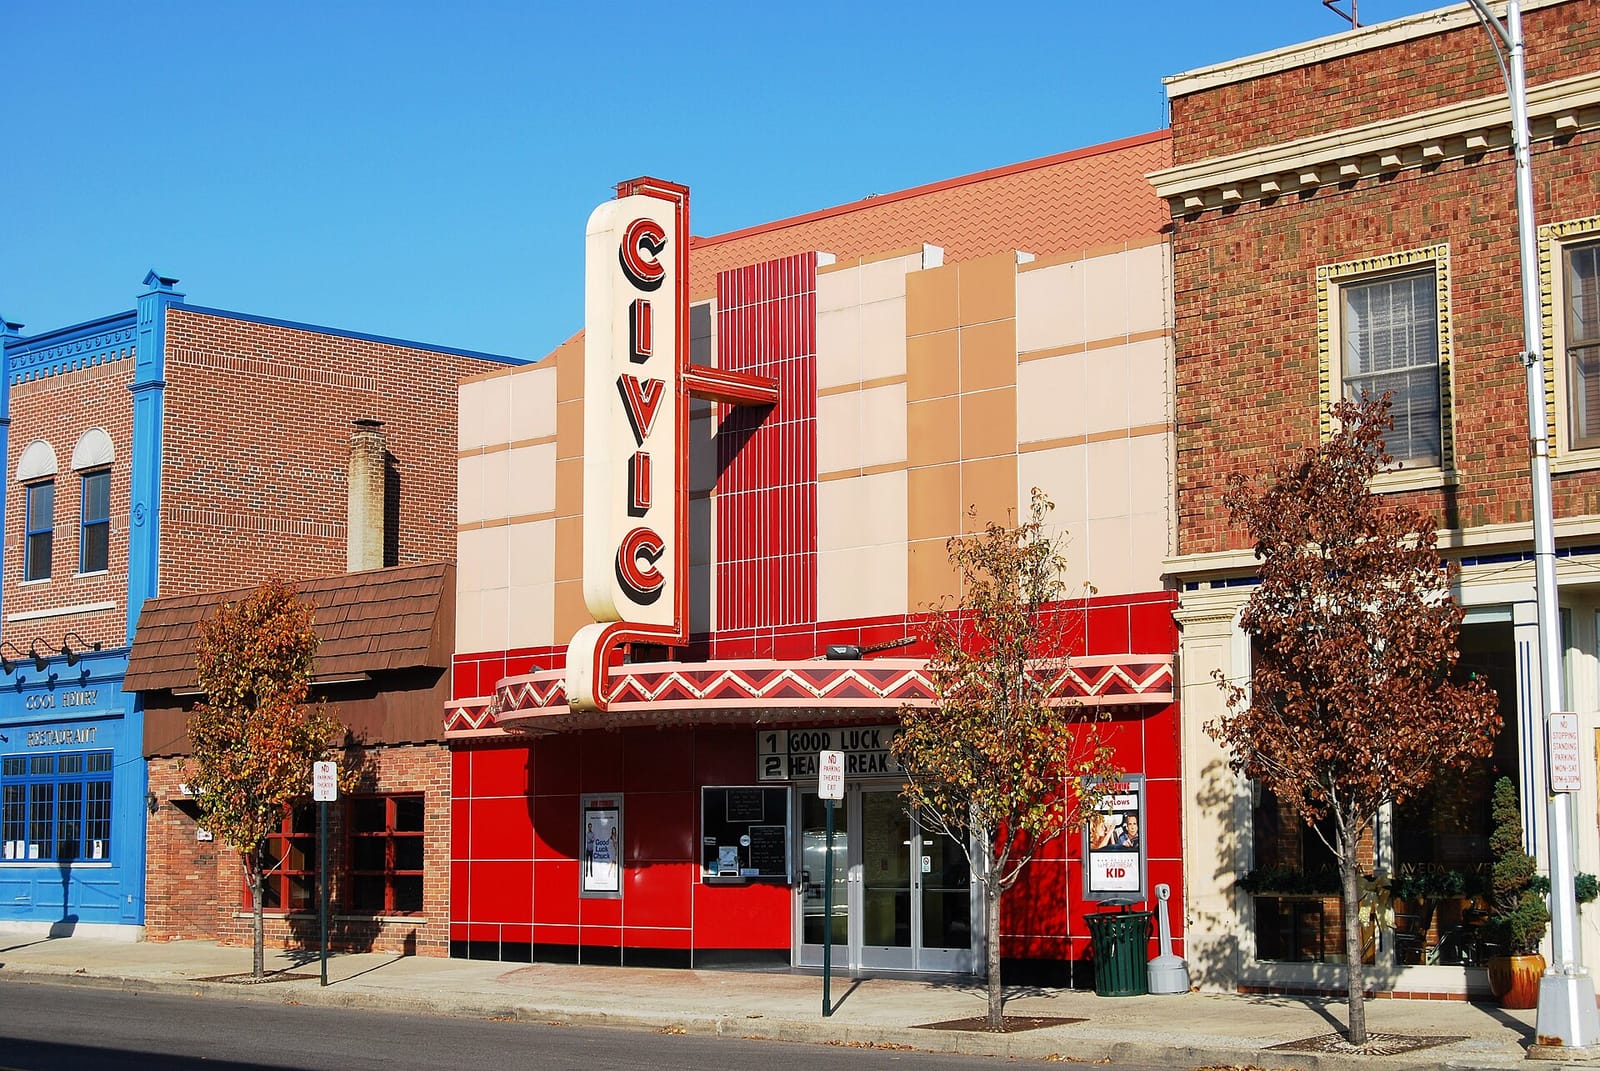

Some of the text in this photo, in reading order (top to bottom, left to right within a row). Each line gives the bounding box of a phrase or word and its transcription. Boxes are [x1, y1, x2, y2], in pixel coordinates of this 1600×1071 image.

[615, 217, 668, 606] CIVIC
[26, 690, 98, 710] COOL HENRY
[27, 727, 97, 747] RESTAURANT
[766, 734, 777, 752] 1
[790, 733, 831, 751] GOOD
[841, 730, 881, 749] LUCK
[1553, 732, 1577, 740] STOPPING
[1553, 743, 1577, 751] STANDING
[765, 757, 782, 776] 2
[828, 755, 837, 764] NO
[1106, 868, 1126, 878] KID
[1400, 862, 1447, 873] AVEDA
